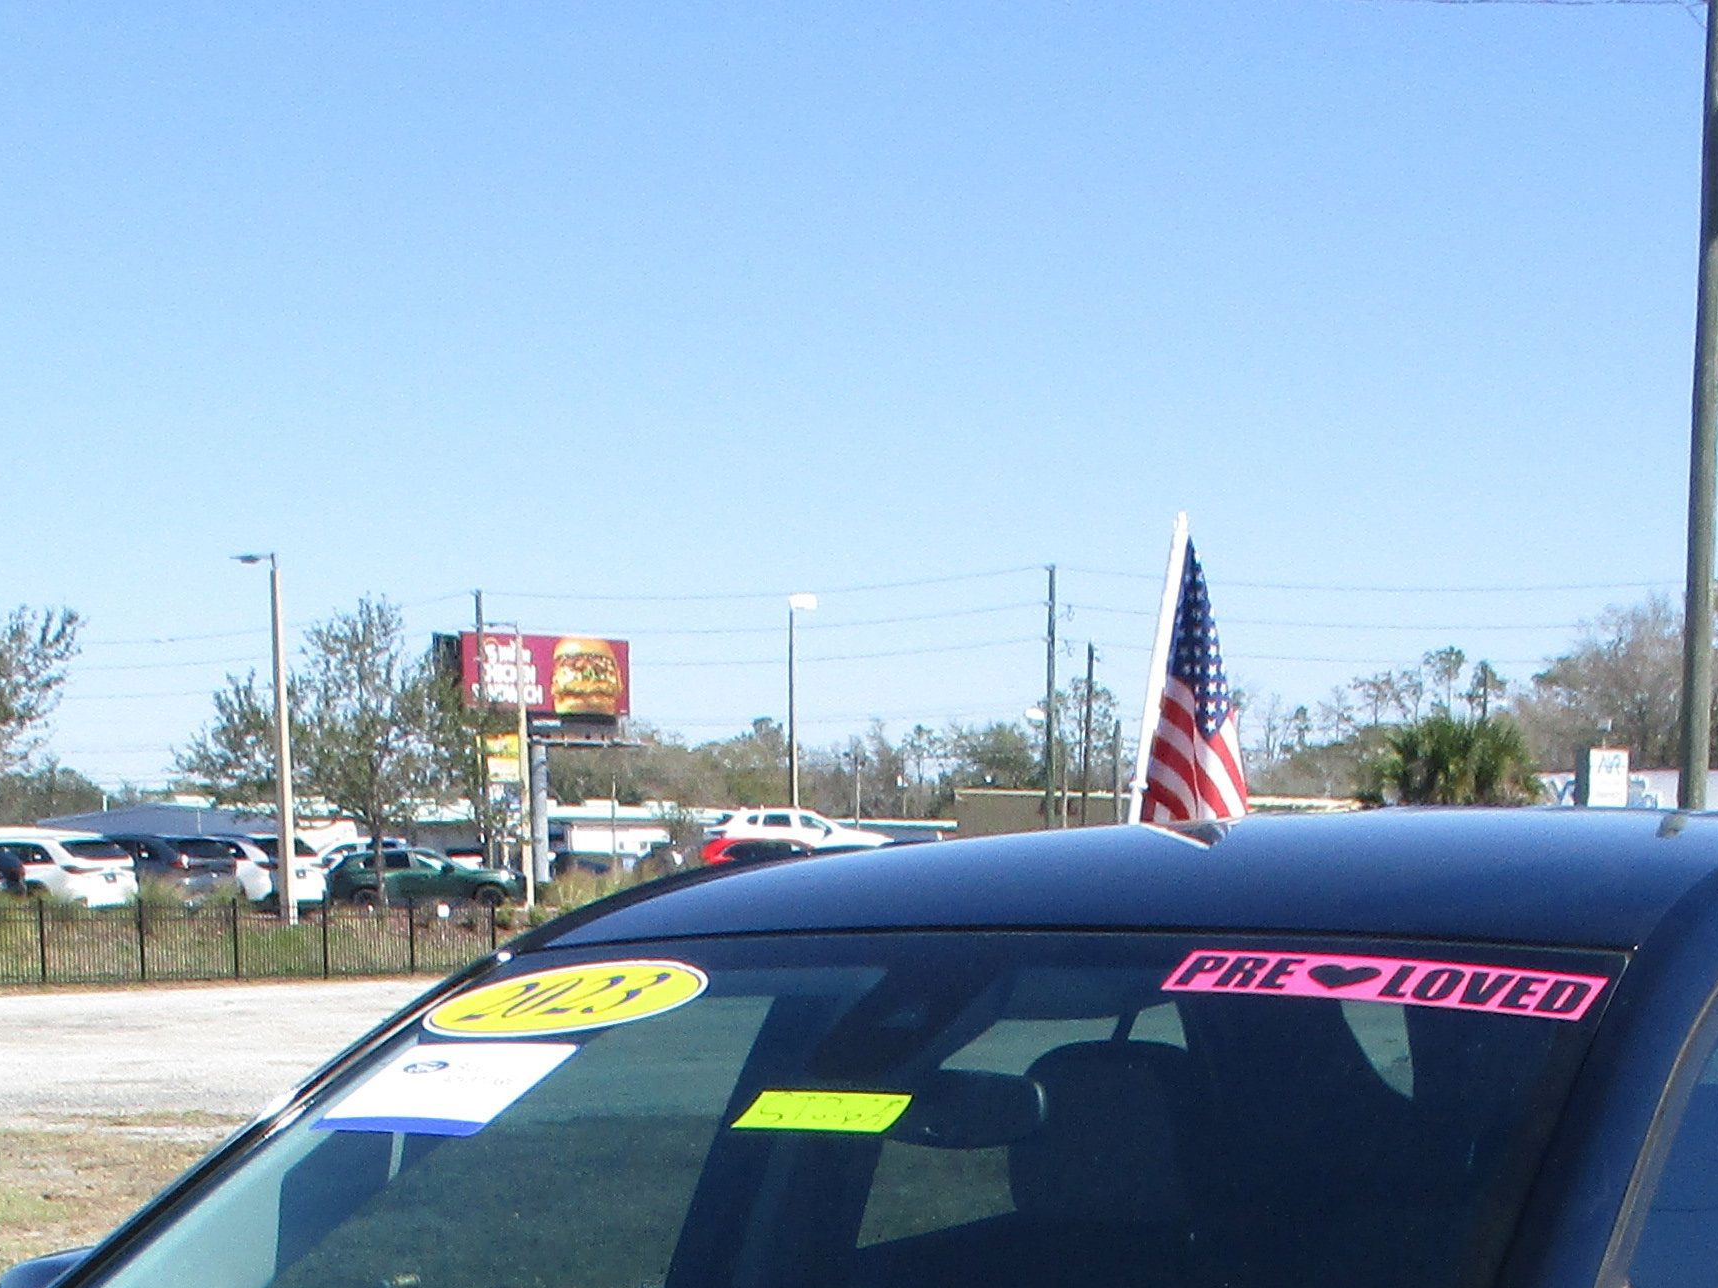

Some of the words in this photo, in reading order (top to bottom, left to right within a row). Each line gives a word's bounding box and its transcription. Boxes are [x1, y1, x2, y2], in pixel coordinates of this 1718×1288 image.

[457, 972, 671, 1021] 2023
[1173, 955, 1306, 990] PRE
[1379, 964, 1592, 1014] LOVED
